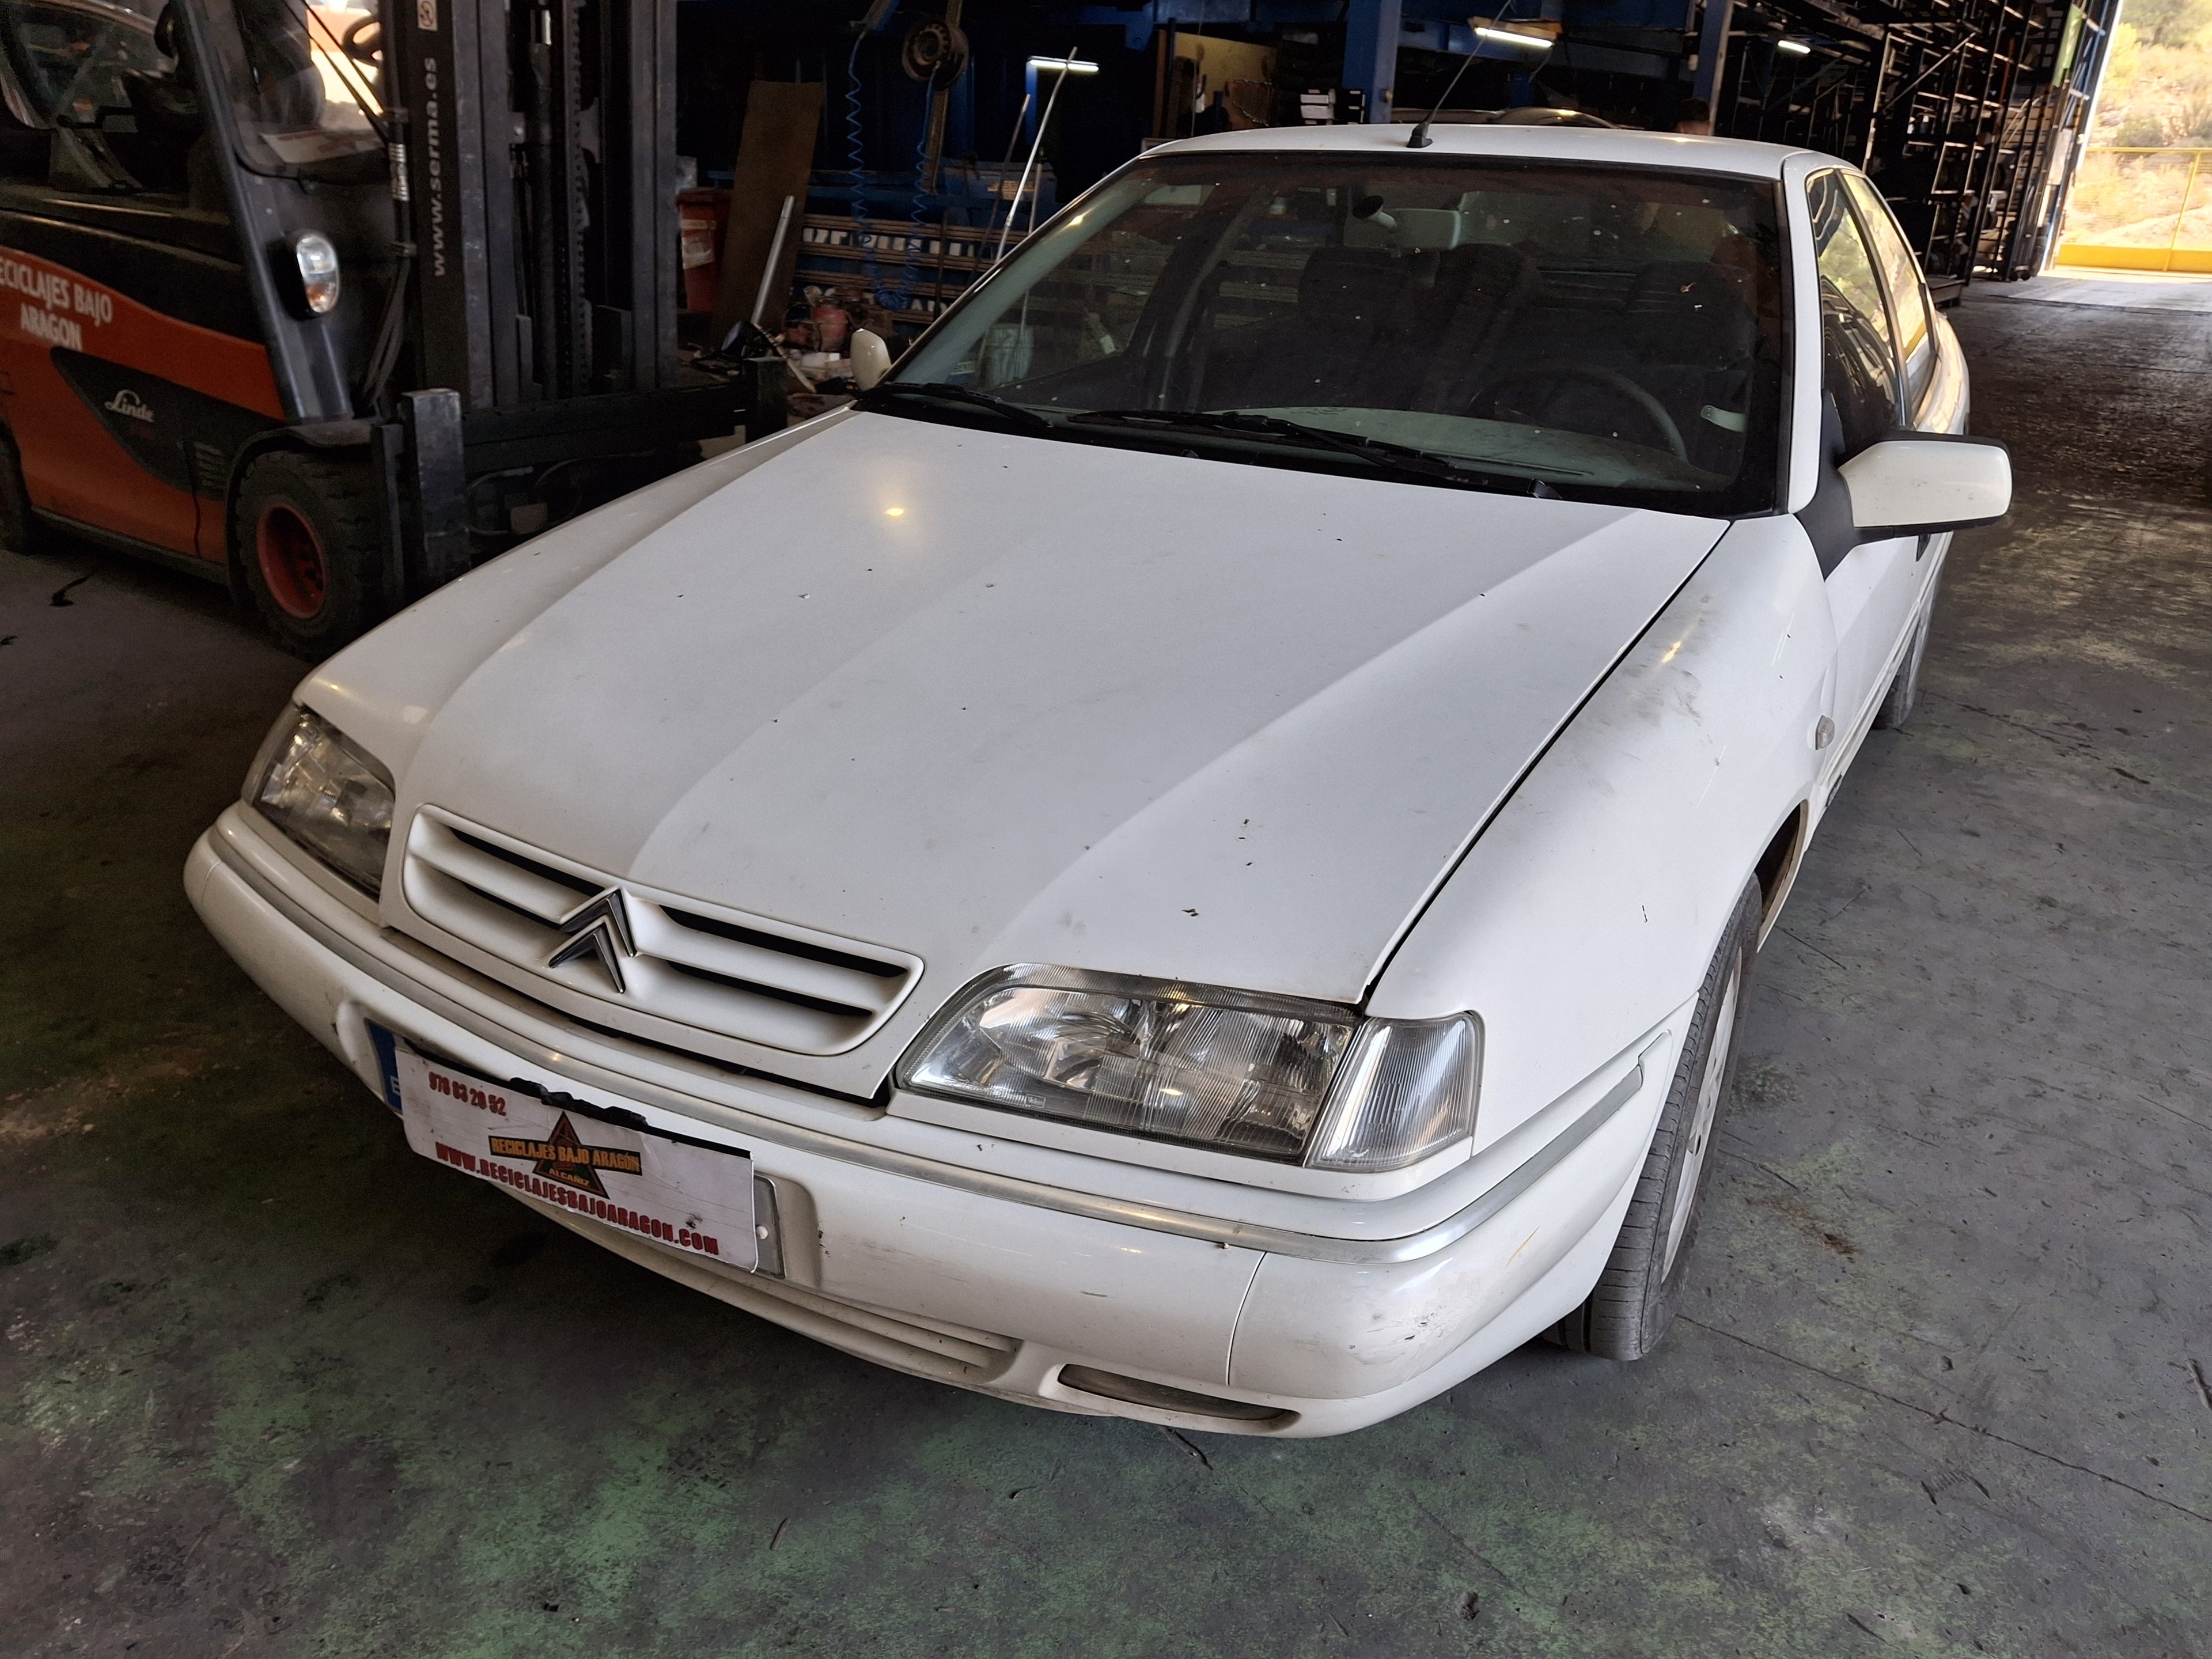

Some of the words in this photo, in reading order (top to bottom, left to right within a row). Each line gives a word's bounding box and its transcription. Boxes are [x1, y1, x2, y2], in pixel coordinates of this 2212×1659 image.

[424, 58, 446, 277] www.serma.es
[73, 283, 113, 327] BAJO
[20, 302, 83, 353] ARAGON
[104, 388, 156, 423] Linde
[488, 1094, 506, 1116] 52
[491, 1138, 556, 1160] RECICLAJES
[558, 1146, 590, 1164] BAJO
[592, 1150, 641, 1172] ARAGÓN
[435, 1142, 719, 1255] WWW.RECICLAJESBAJOARAGON.COM
